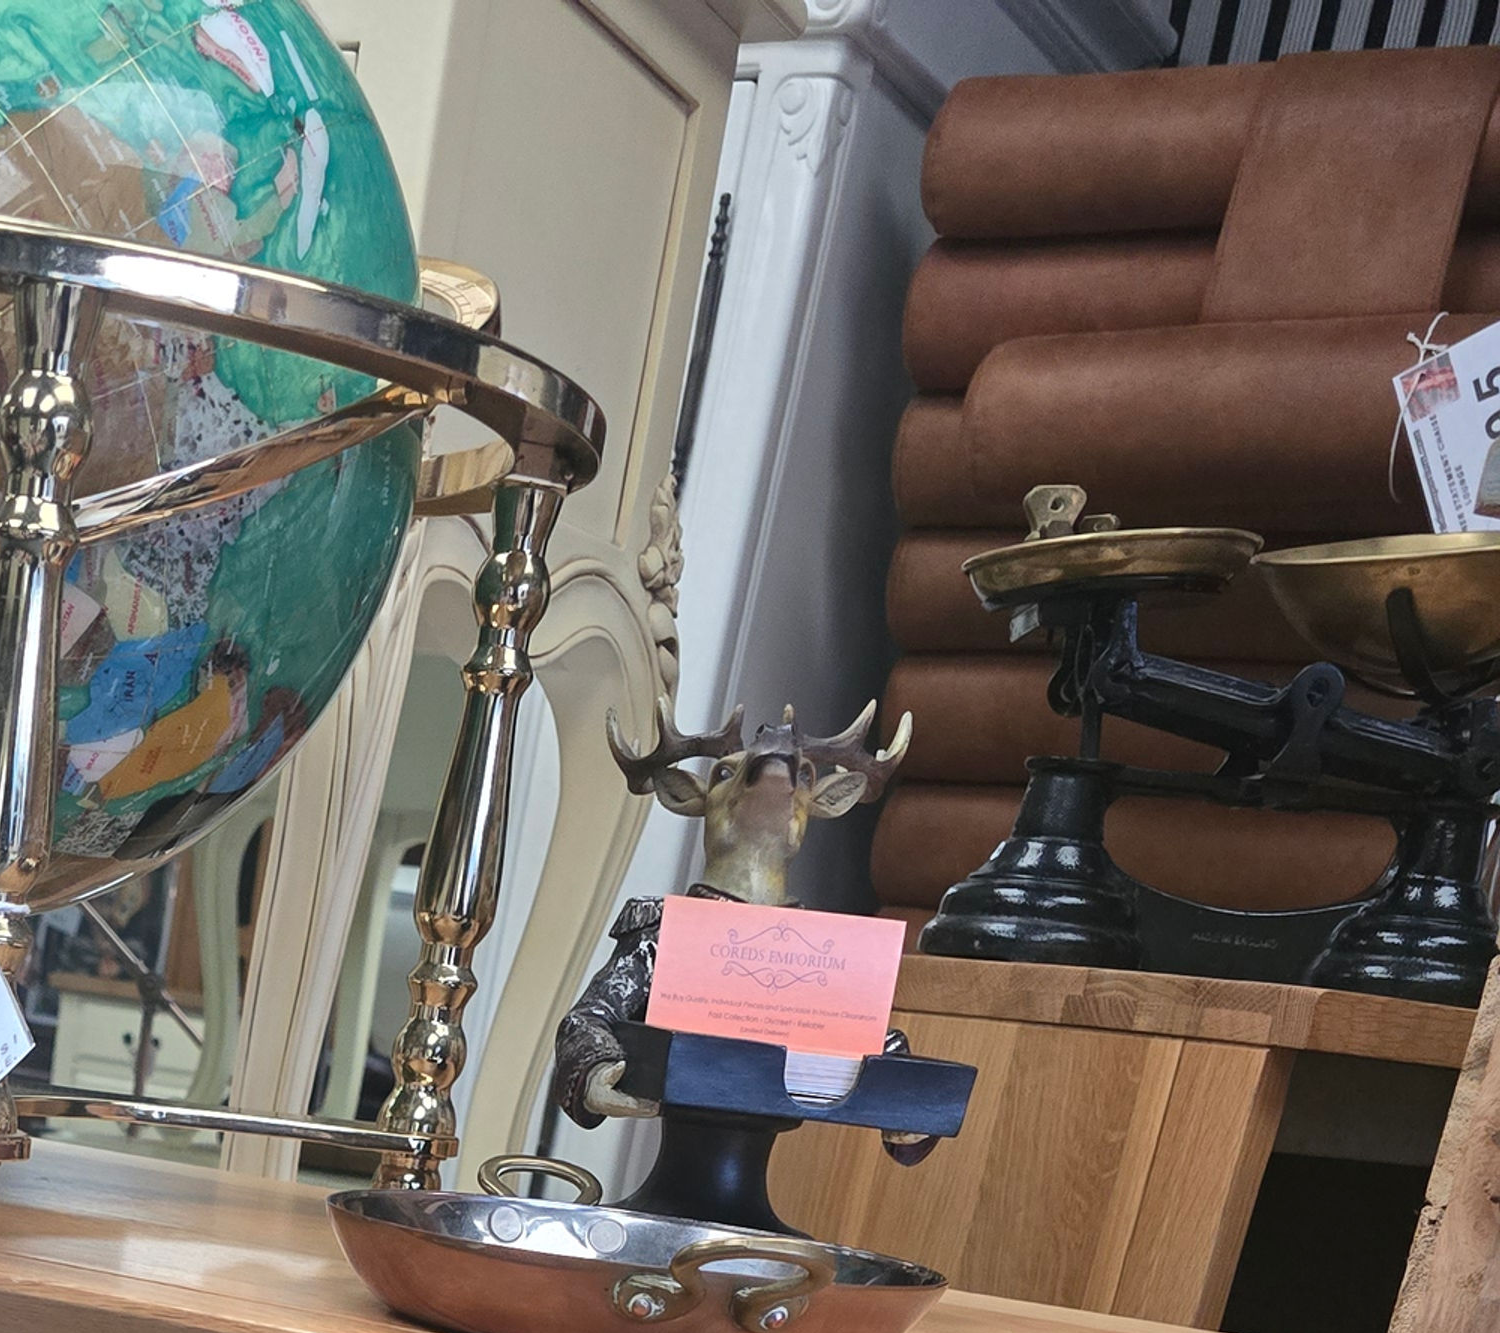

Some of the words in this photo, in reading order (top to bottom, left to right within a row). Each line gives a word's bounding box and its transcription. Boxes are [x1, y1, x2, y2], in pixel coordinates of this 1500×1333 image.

[123, 669, 138, 704] IRAN
[708, 942, 765, 963] COREDS
[767, 949, 846, 972] EMPORIUM
[723, 1012, 758, 1023] Collection
[763, 1016, 791, 1026] Discreet
[796, 1020, 825, 1030] Reliable
